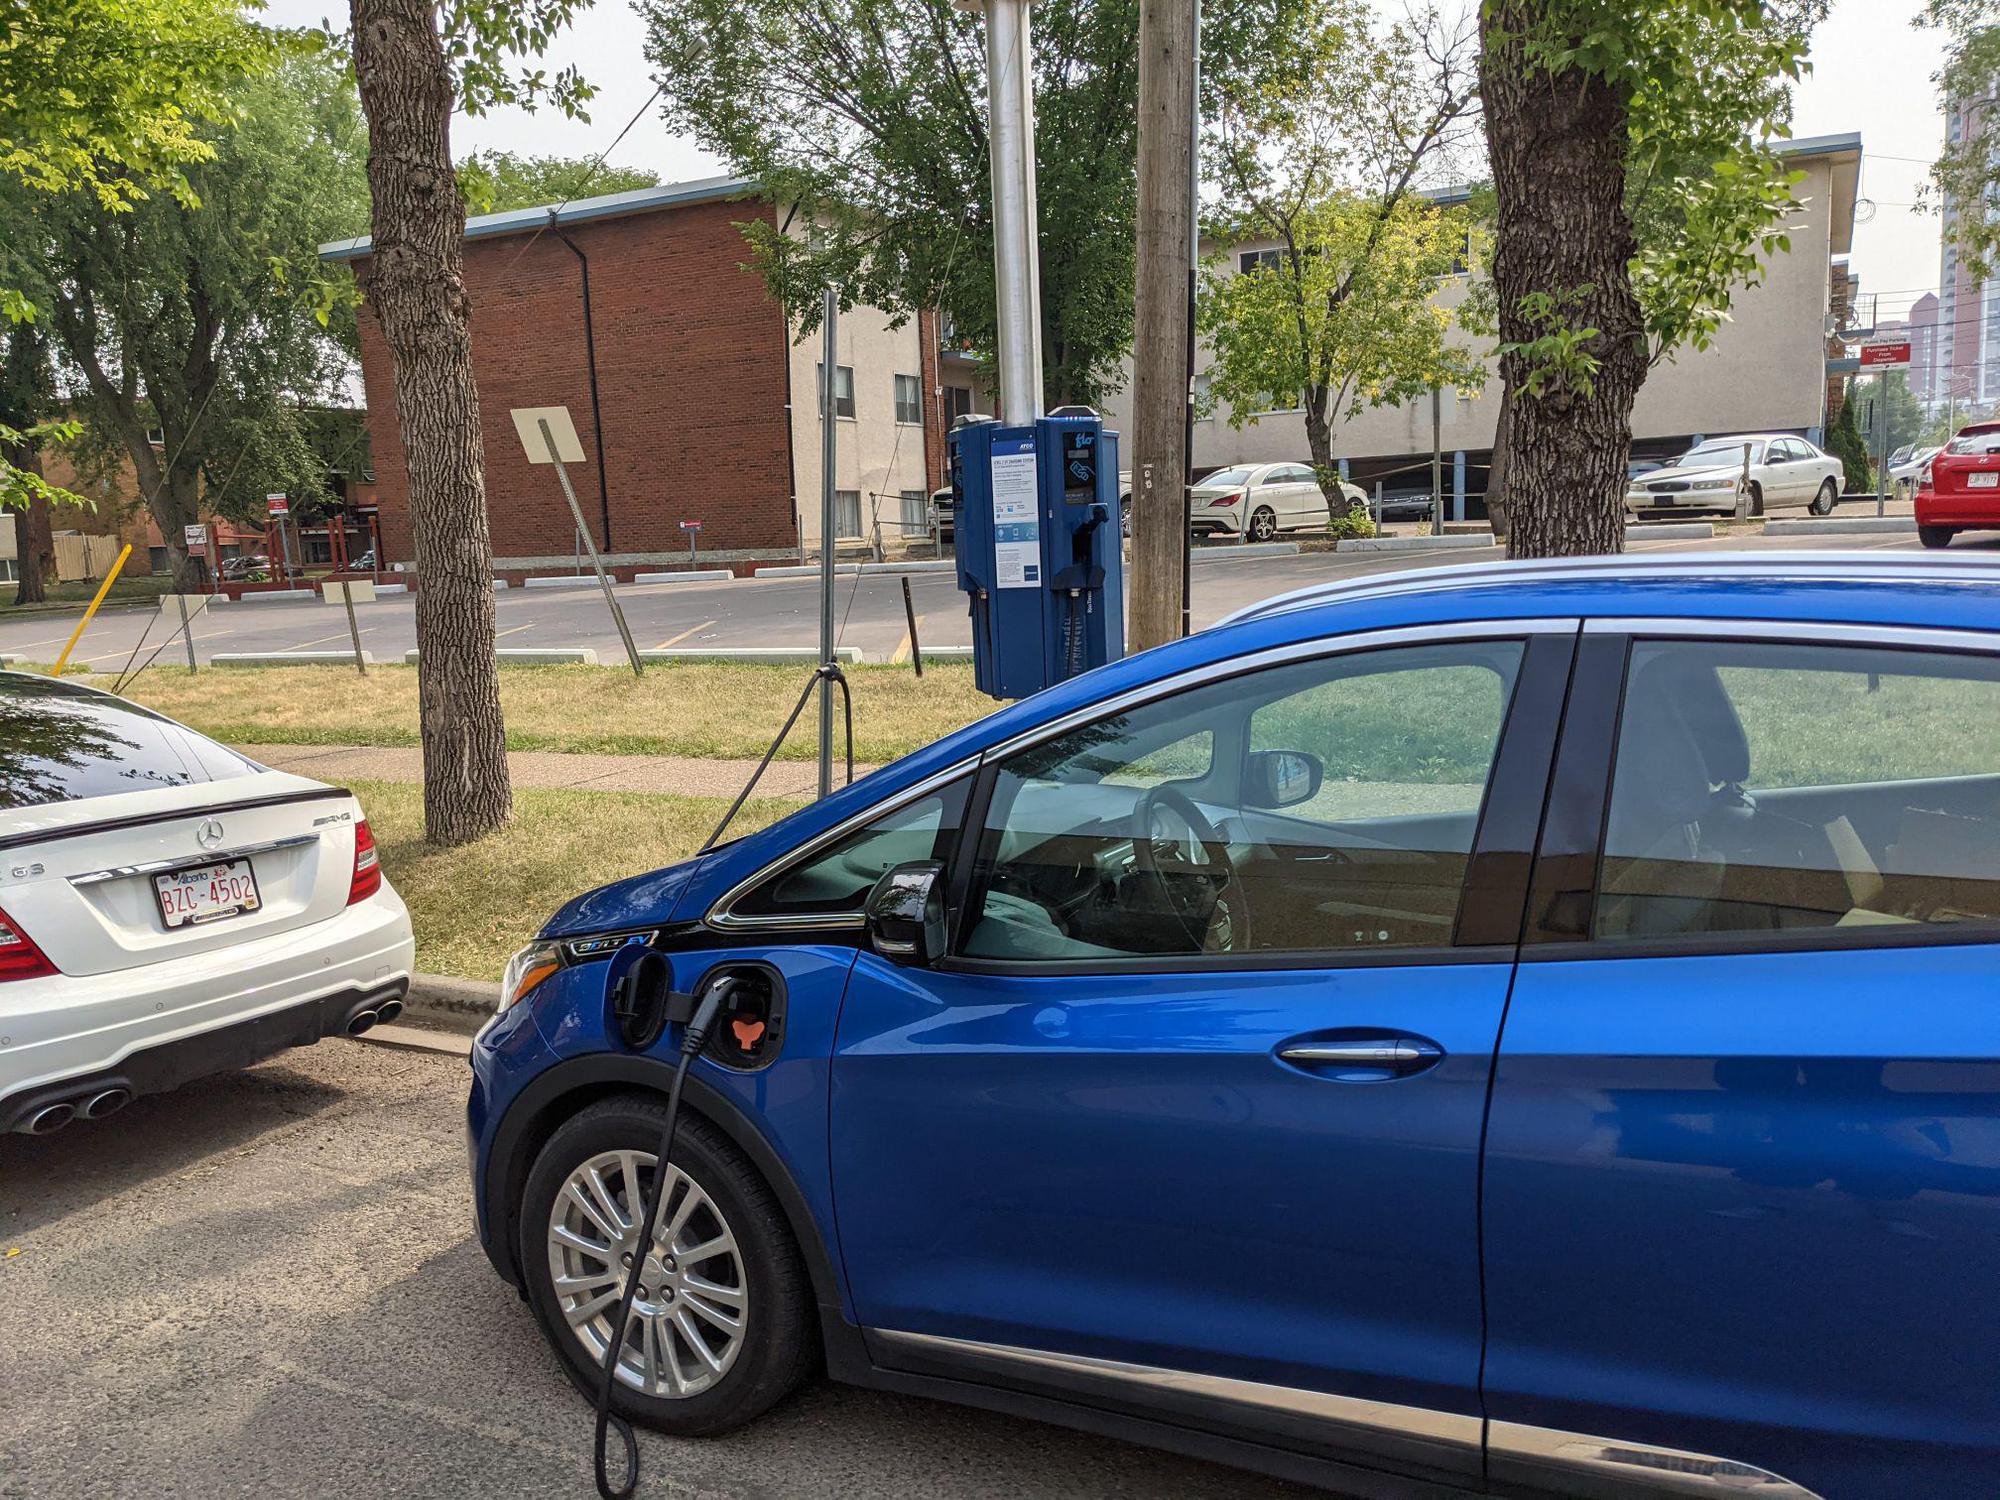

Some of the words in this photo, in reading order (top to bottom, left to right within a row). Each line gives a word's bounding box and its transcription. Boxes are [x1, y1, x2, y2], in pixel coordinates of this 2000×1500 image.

[1075, 432, 1095, 449] flo
[12, 862, 45, 878] 63
[177, 872, 208, 885] Alberta
[161, 875, 254, 915] BZC-4502
[627, 934, 651, 944] EV
